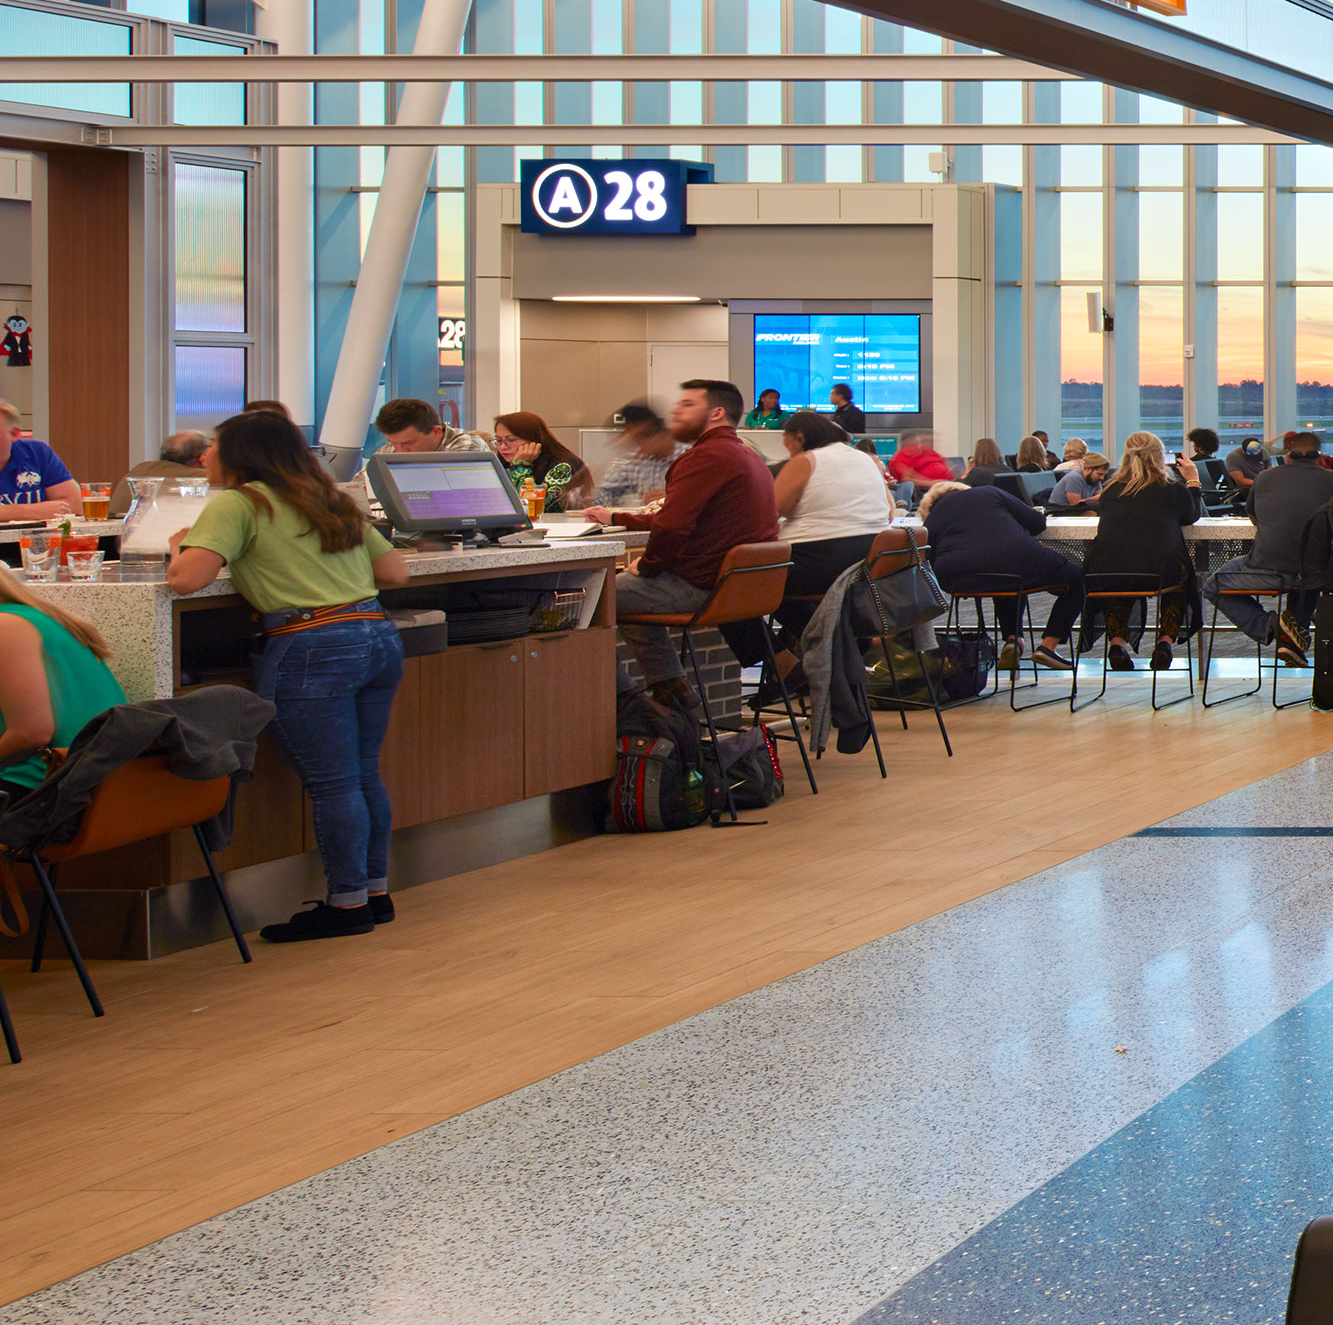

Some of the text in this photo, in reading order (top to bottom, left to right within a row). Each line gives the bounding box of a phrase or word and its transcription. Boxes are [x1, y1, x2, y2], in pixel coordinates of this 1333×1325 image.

[547, 170, 668, 222] A 28
[756, 333, 821, 342] FRONTIER
